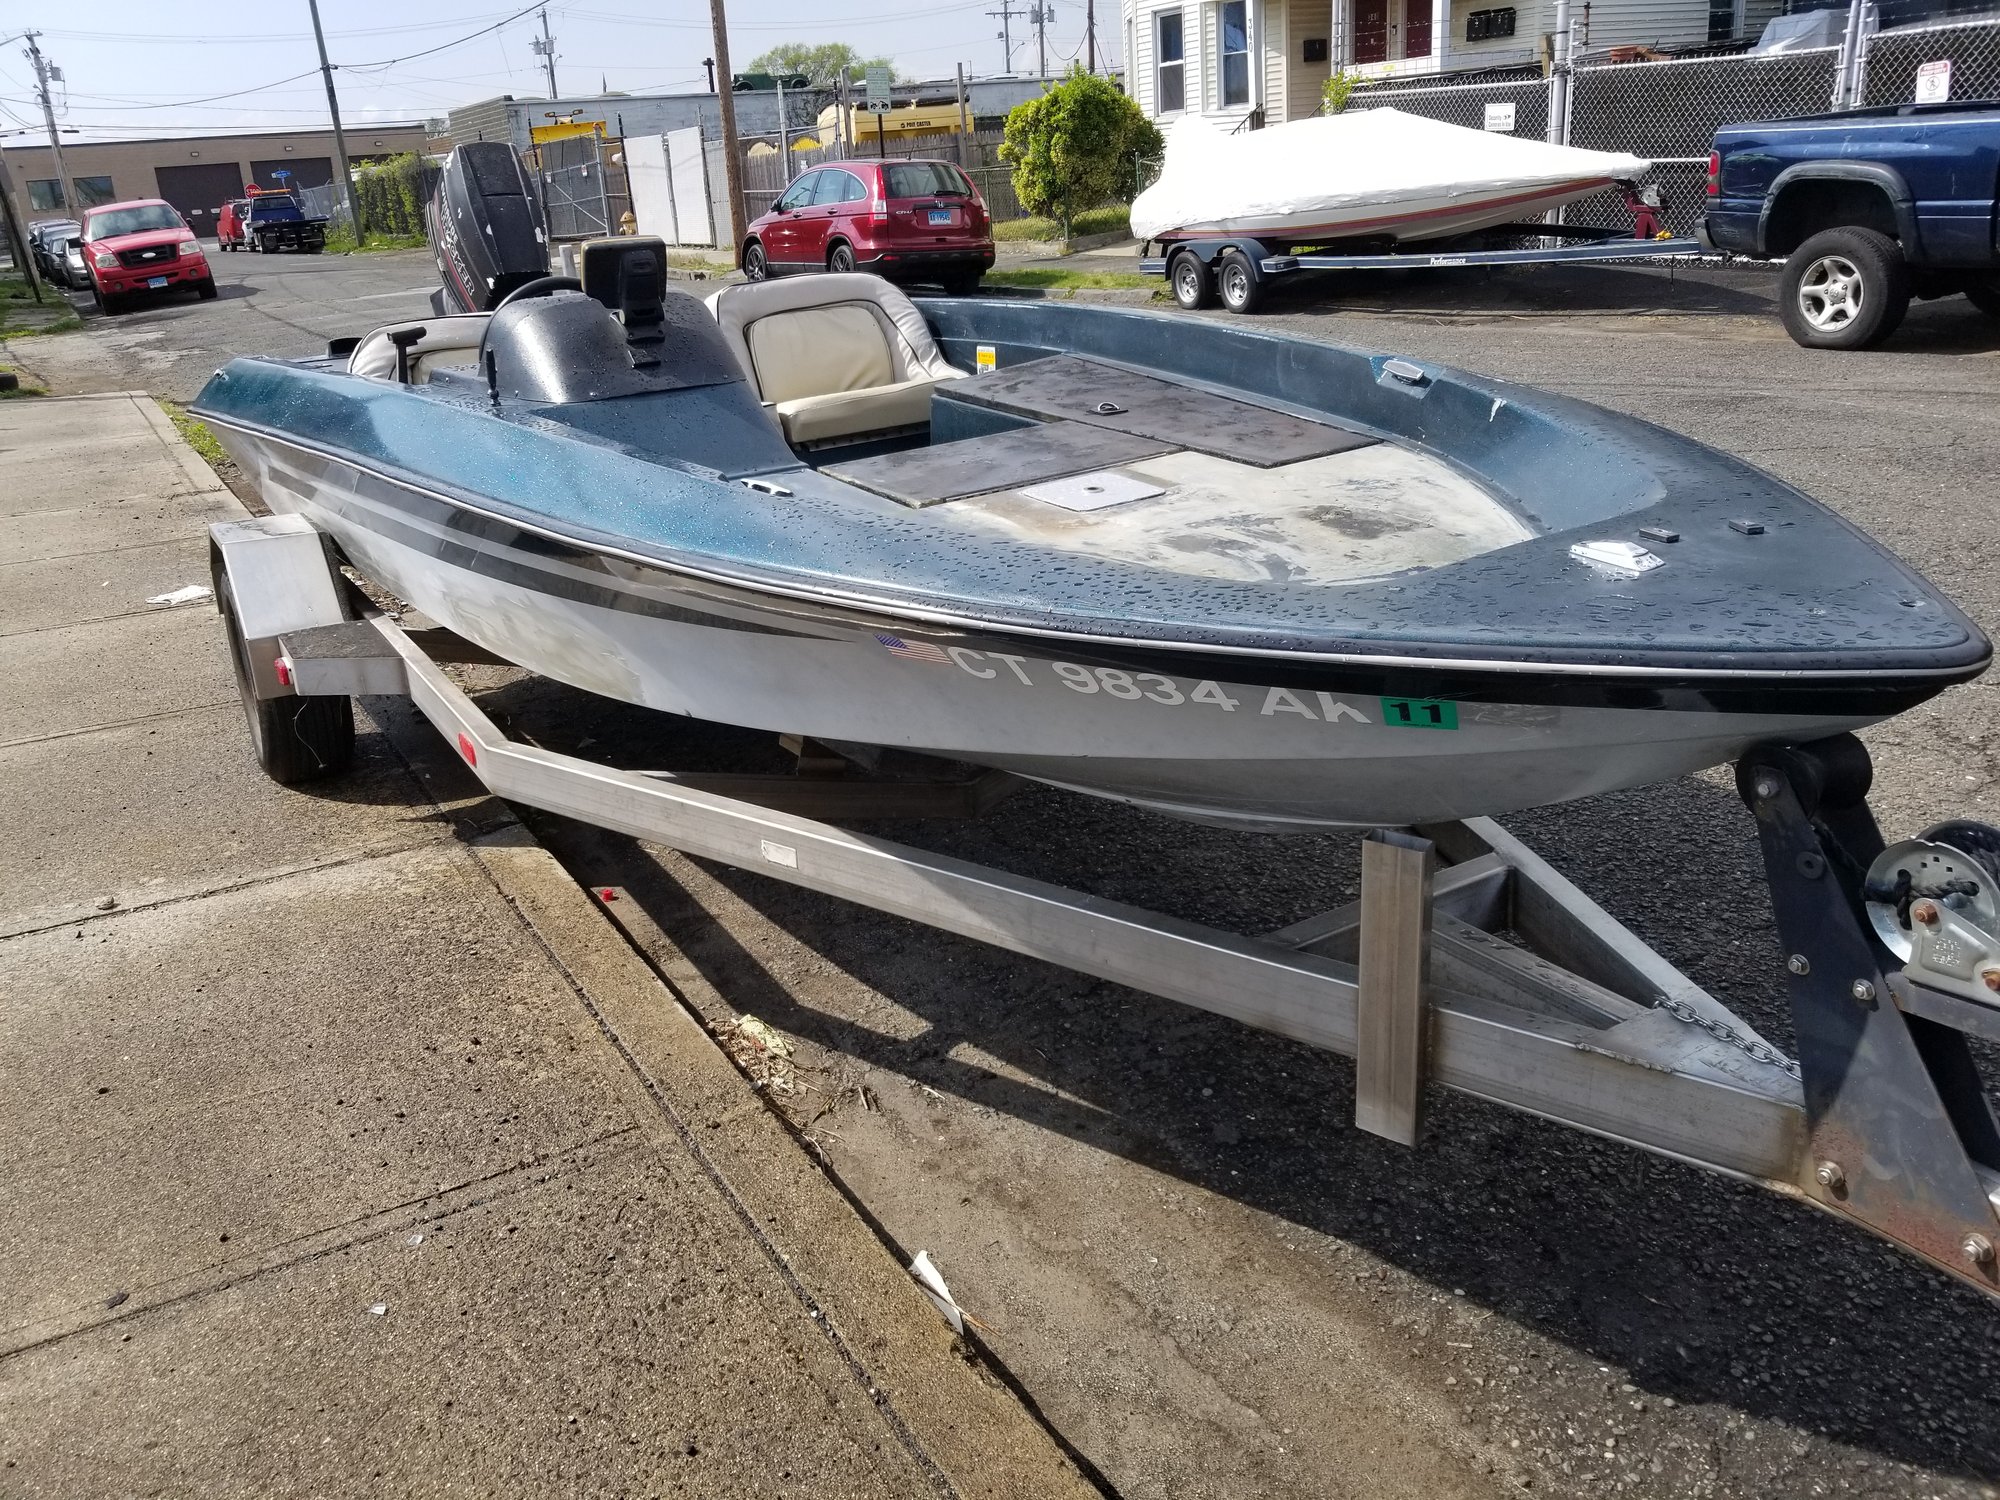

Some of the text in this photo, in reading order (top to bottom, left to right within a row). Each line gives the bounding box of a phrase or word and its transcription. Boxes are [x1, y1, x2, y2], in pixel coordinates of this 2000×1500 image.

[948, 646, 1033, 686] CT
[1051, 661, 1240, 712] 9834
[1390, 702, 1442, 724] 11
